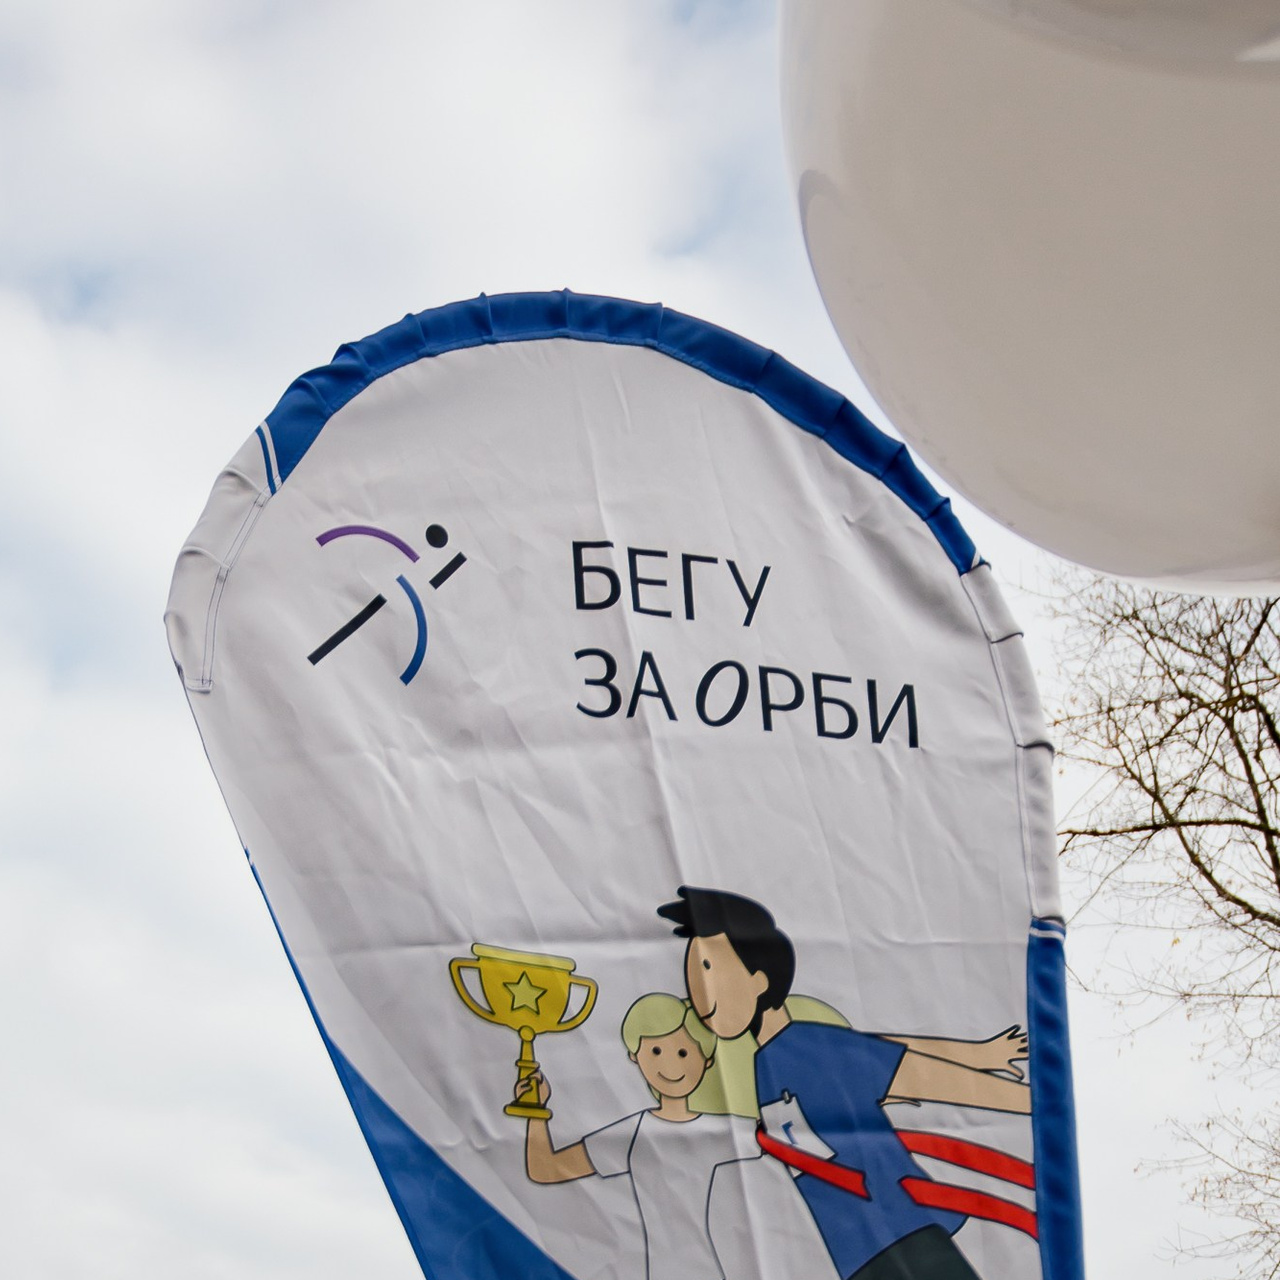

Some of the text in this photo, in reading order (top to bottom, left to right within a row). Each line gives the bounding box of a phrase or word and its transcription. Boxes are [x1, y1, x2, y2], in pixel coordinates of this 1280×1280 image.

[572, 540, 772, 627] БЕГУ
[574, 647, 920, 749] ЗА ОРБИ
